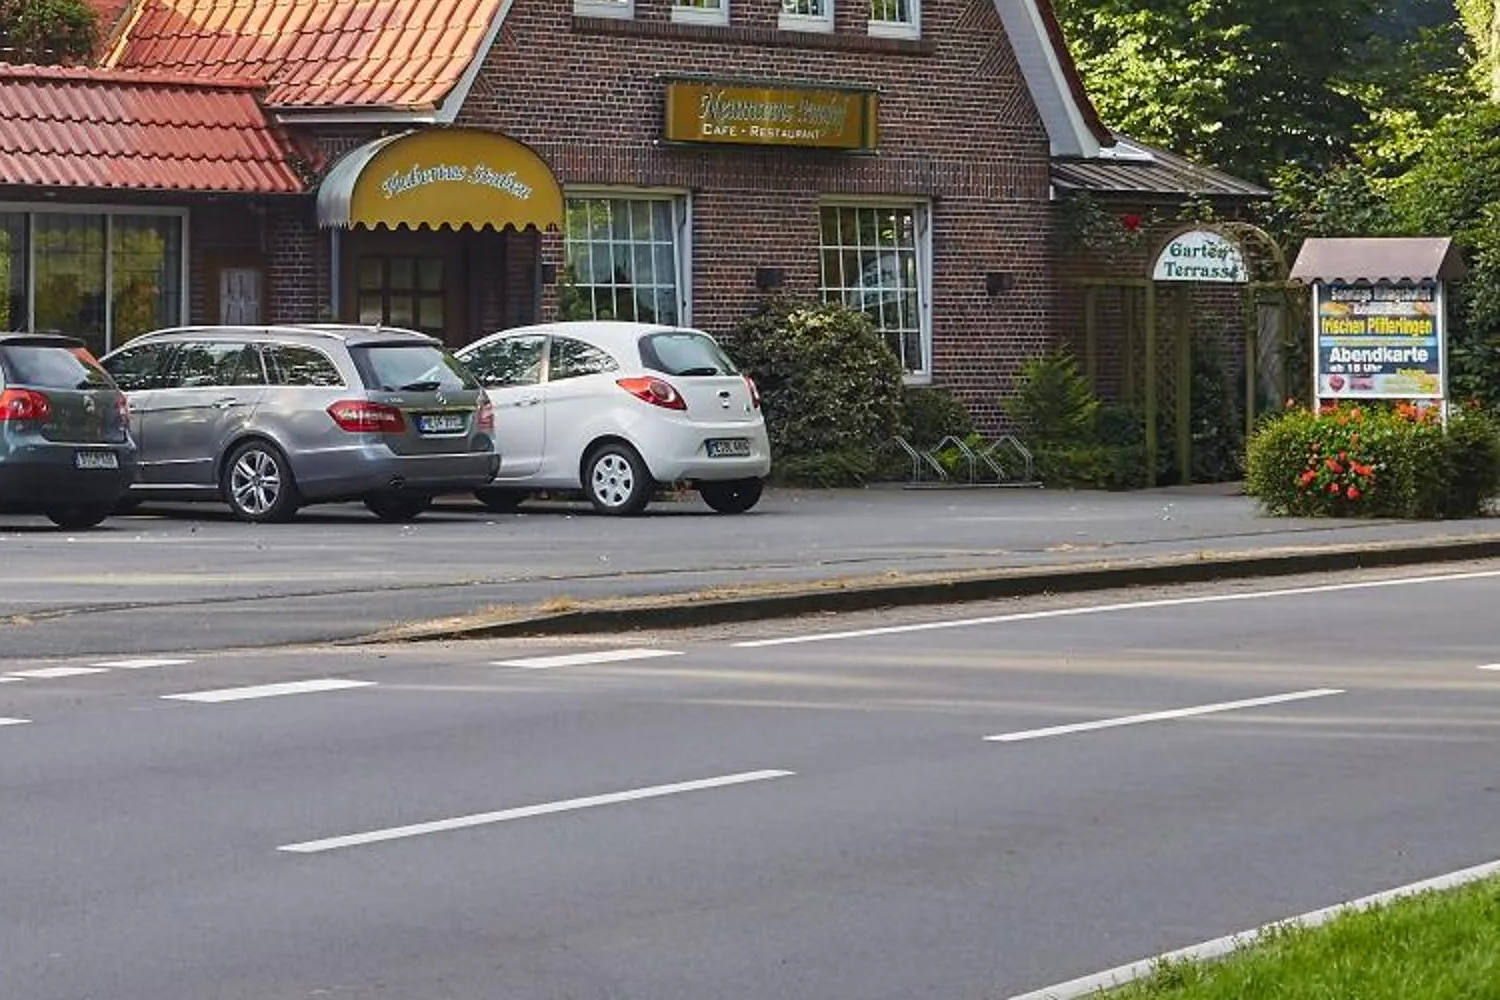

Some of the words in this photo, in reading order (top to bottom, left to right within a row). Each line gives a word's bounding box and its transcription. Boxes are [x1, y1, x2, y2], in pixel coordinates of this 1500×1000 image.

[380, 163, 467, 199] Hubertus
[468, 162, 532, 201] Stuben
[1169, 241, 1229, 260] Garten
[1163, 260, 1238, 279] Terrasse
[1329, 347, 1429, 363] Abendkarte
[1329, 363, 1344, 373] ab
[1363, 363, 1384, 373] Uhr
